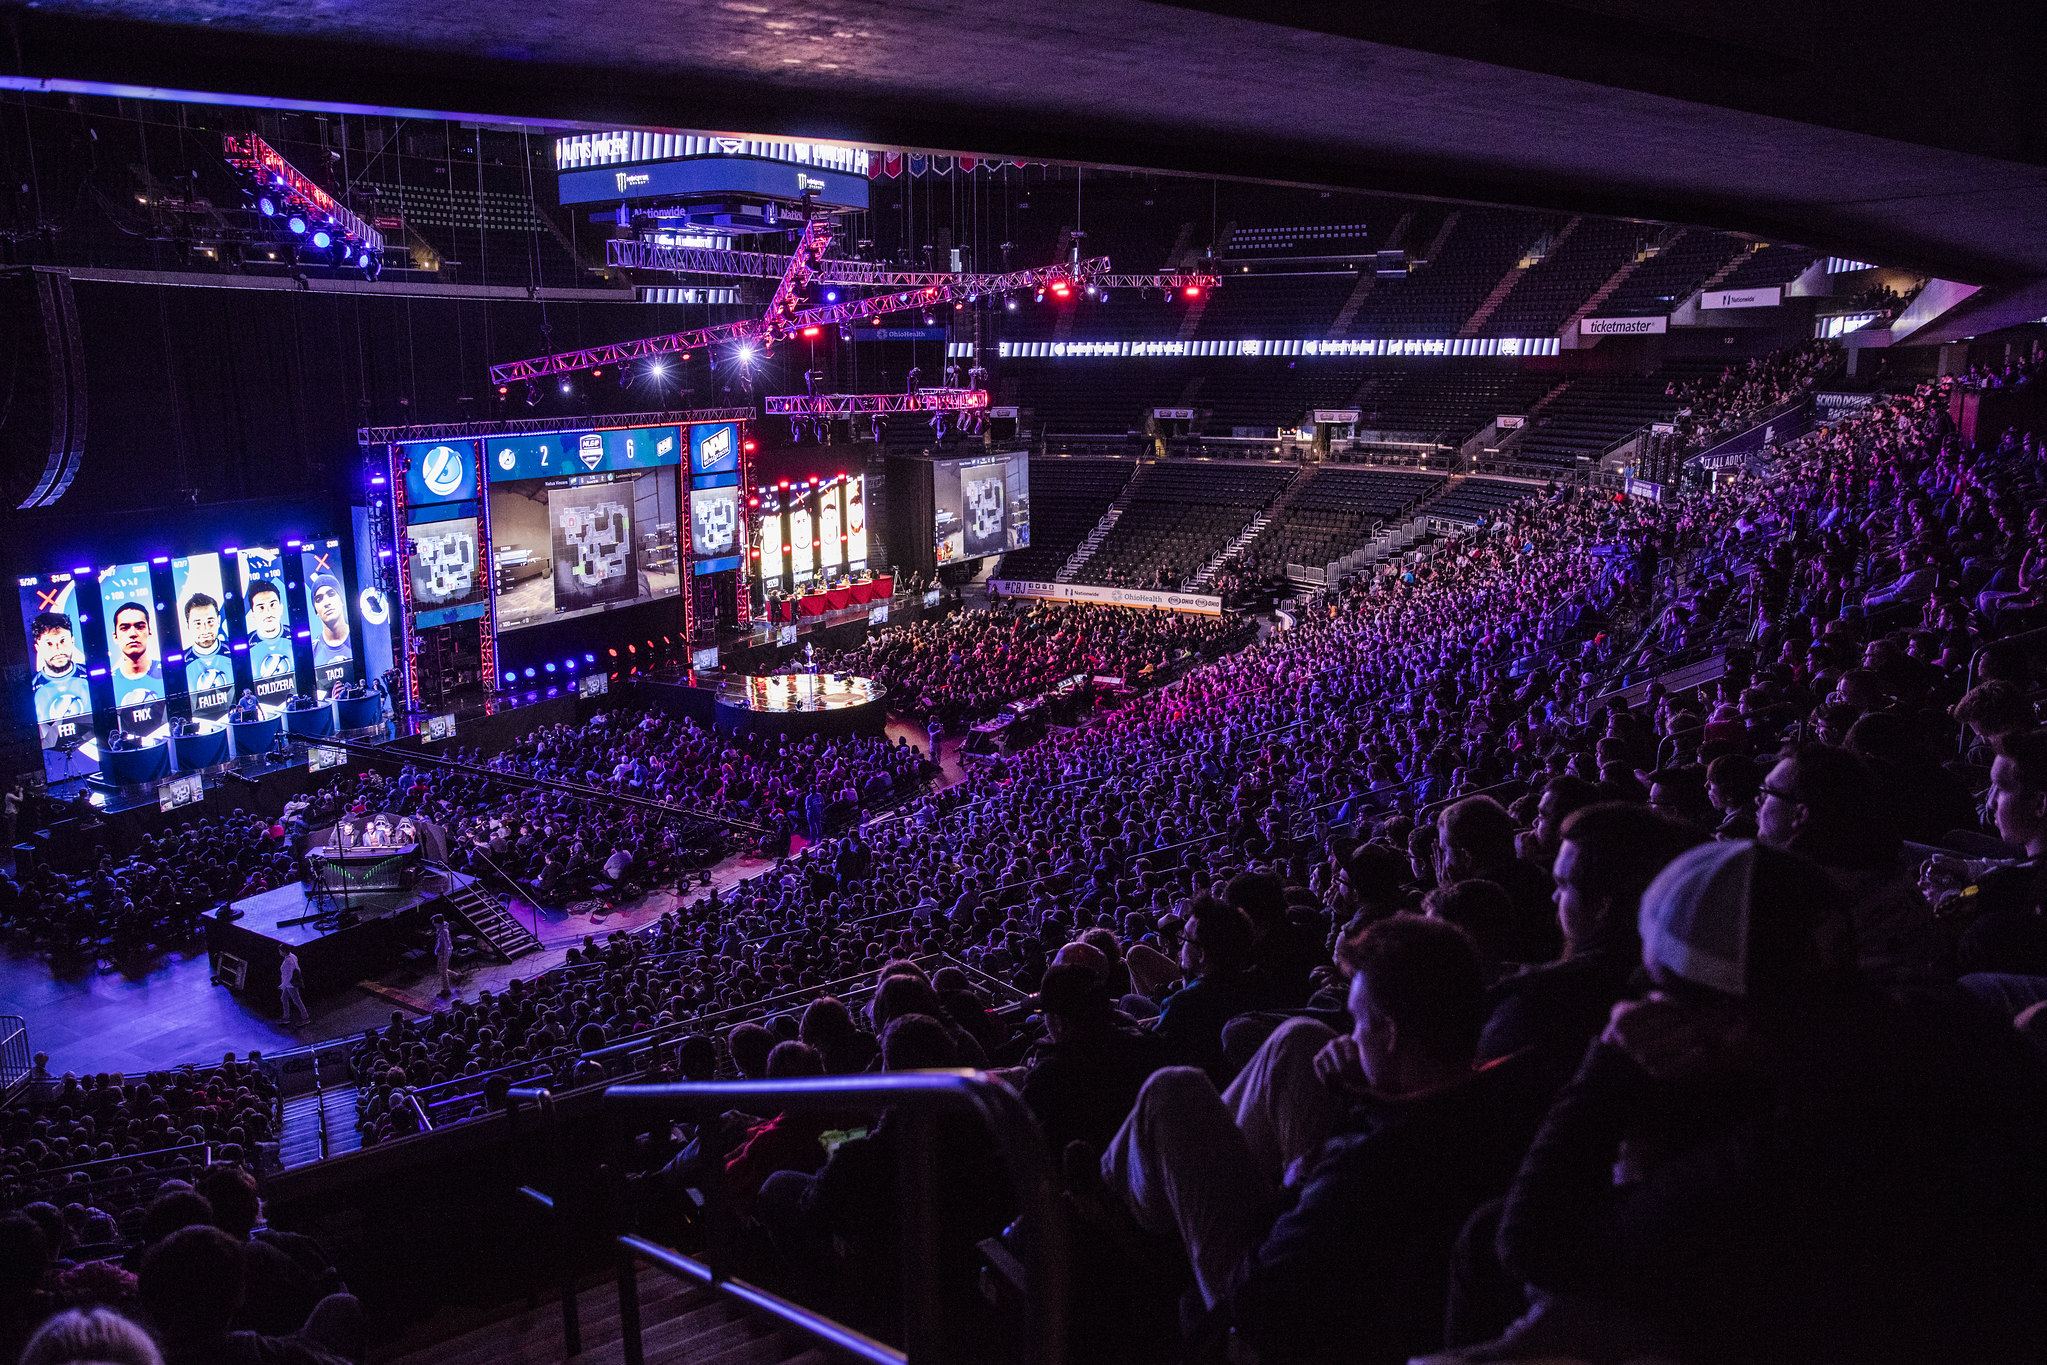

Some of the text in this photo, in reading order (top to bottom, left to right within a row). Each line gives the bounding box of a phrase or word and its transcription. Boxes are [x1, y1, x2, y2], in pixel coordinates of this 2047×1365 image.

[1731, 296, 1755, 304] Nationwide
[888, 330, 926, 338] OhioHealth
[1590, 320, 1651, 334] ticketmaster
[1724, 336, 1735, 344] 122
[1816, 394, 1842, 407] SCIOTO
[540, 445, 549, 467] 2
[626, 439, 634, 459] 6
[1711, 456, 1723, 468] ALL
[1005, 581, 1026, 594] #CBJ
[1124, 592, 1163, 604] OhioHealth
[325, 667, 344, 681] TACO
[256, 678, 295, 696] COLDZERA
[198, 692, 228, 709] FALLEN
[133, 708, 152, 723] FNX
[58, 722, 76, 738] FER
